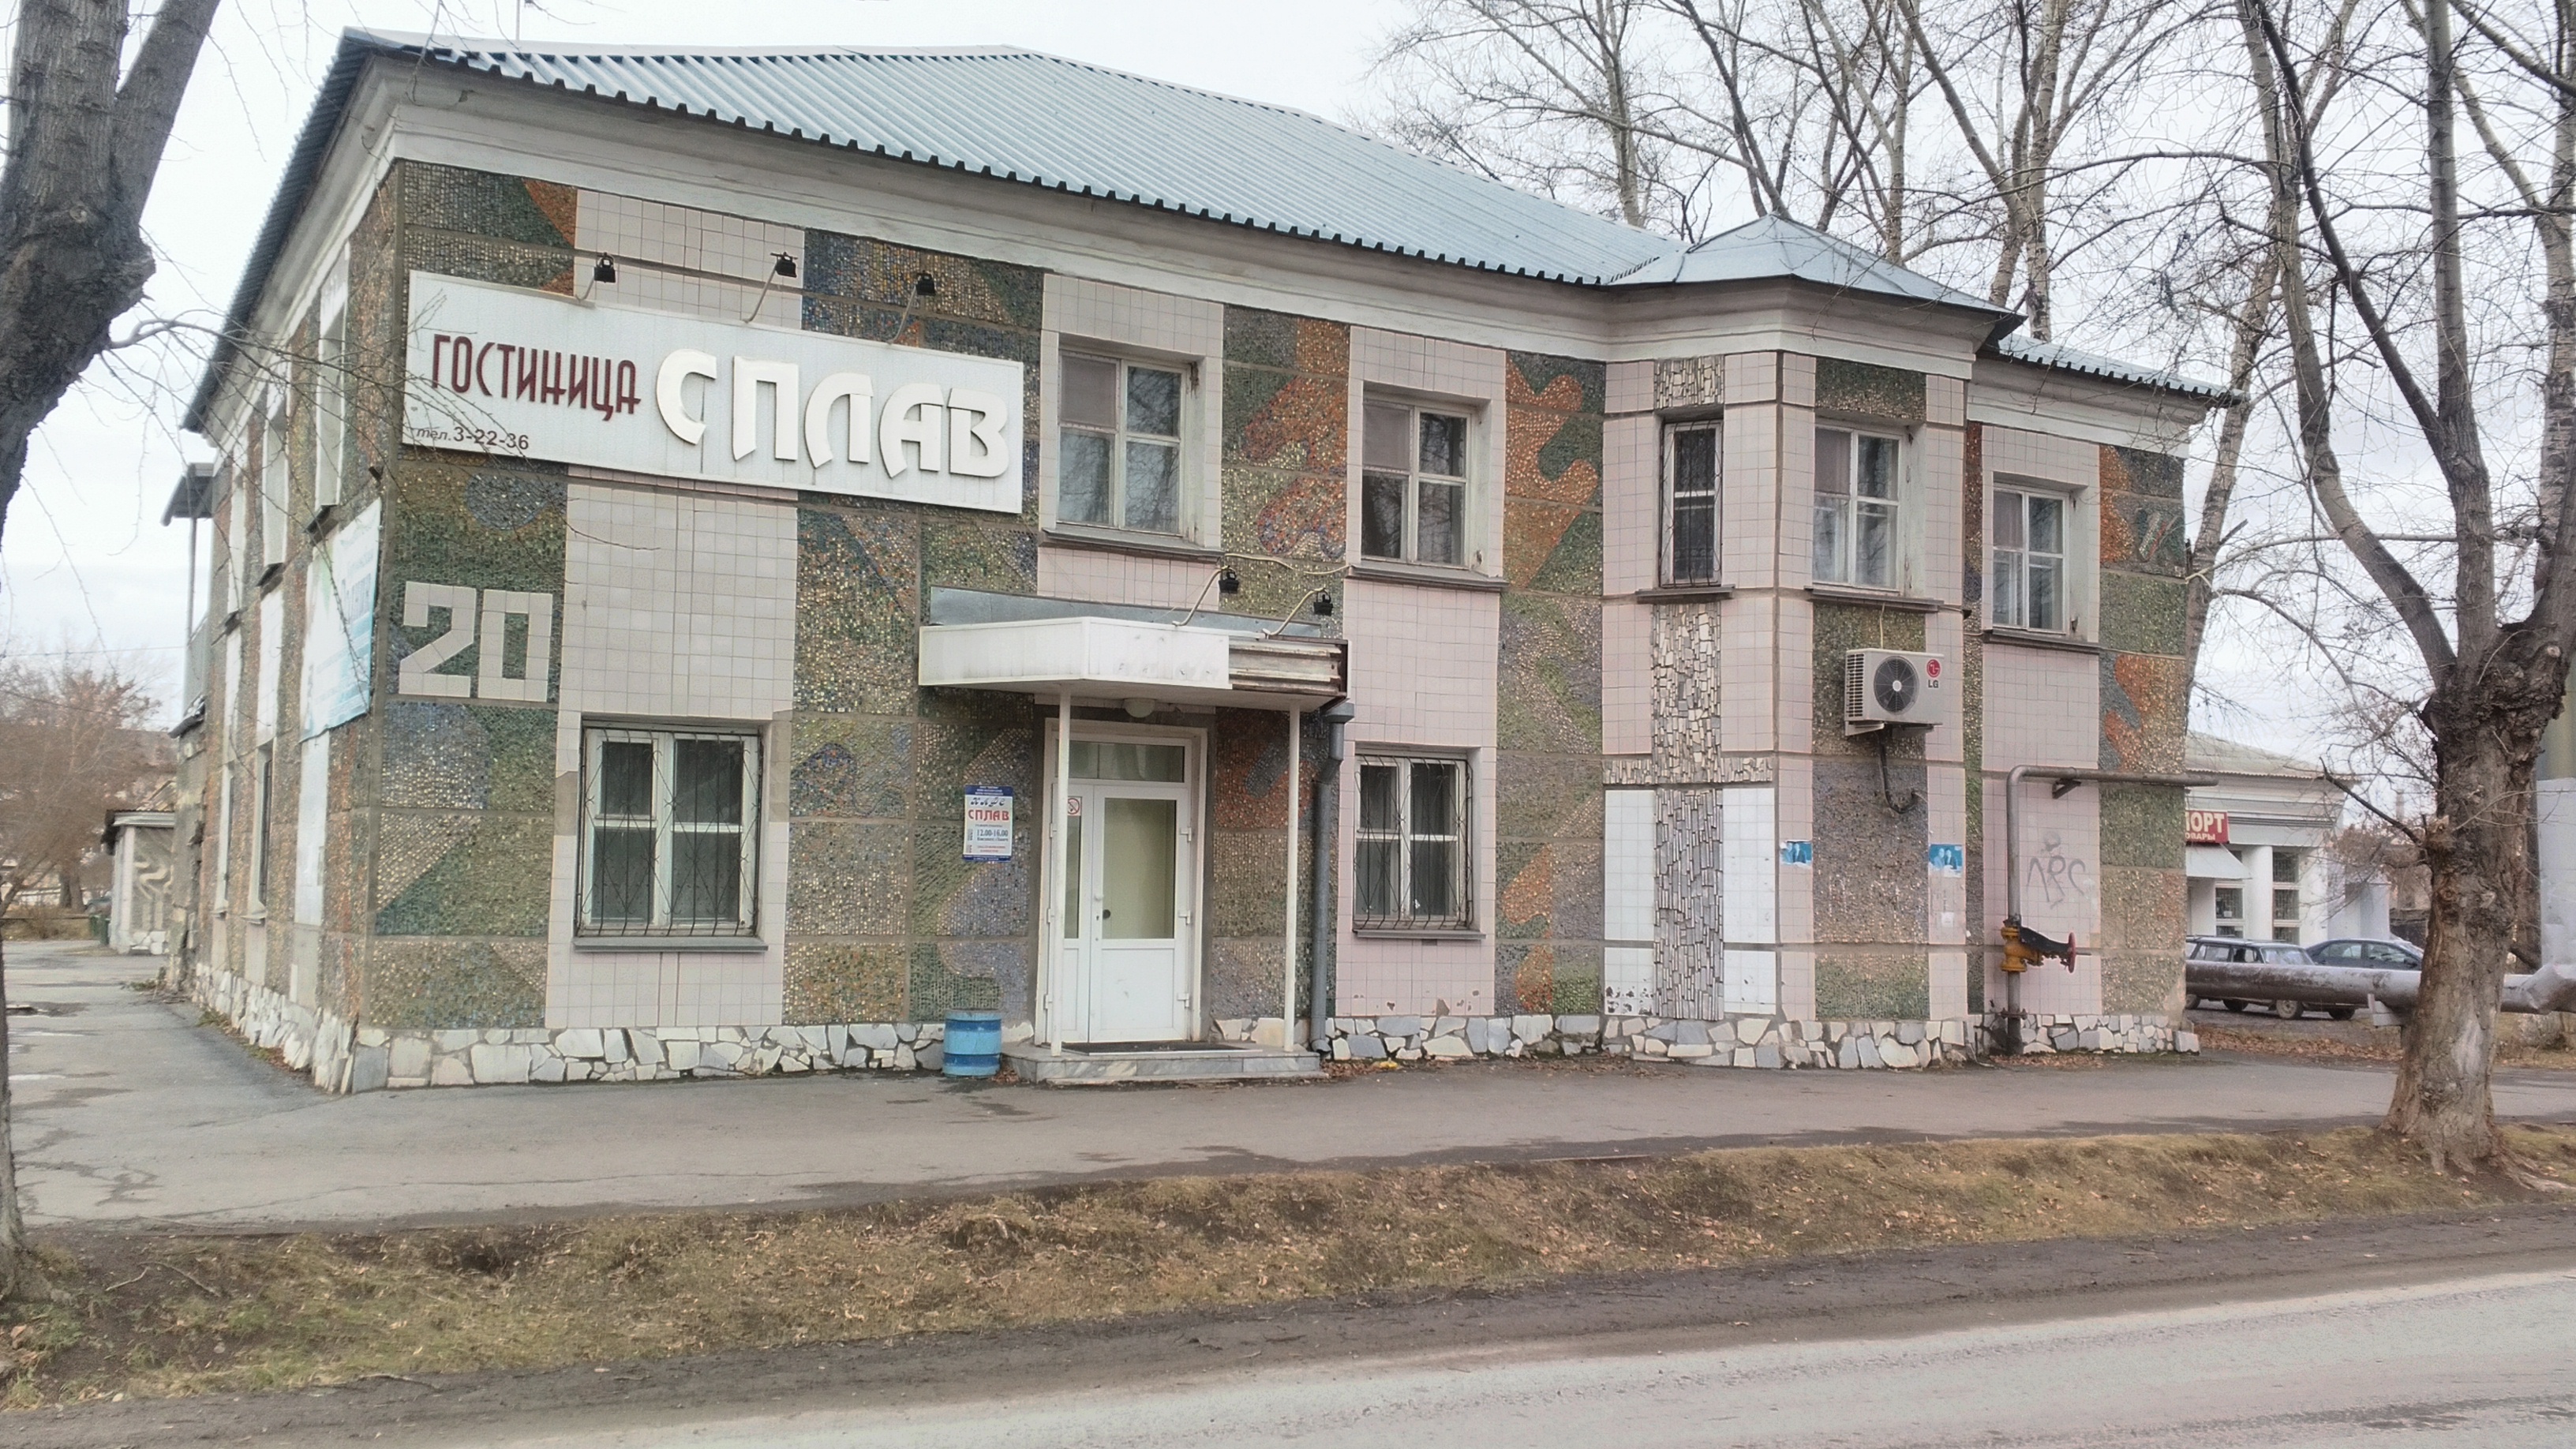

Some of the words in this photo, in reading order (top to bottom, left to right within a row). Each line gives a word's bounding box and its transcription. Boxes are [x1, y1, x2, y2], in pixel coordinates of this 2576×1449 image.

[432, 333, 642, 421] ГОСТИНИЦА
[656, 348, 1009, 478] СПЛАВ
[398, 581, 553, 702] 20
[1928, 680, 1939, 688] LG
[968, 809, 1009, 821] СПЛАВ
[2185, 811, 2225, 833] ОРТ
